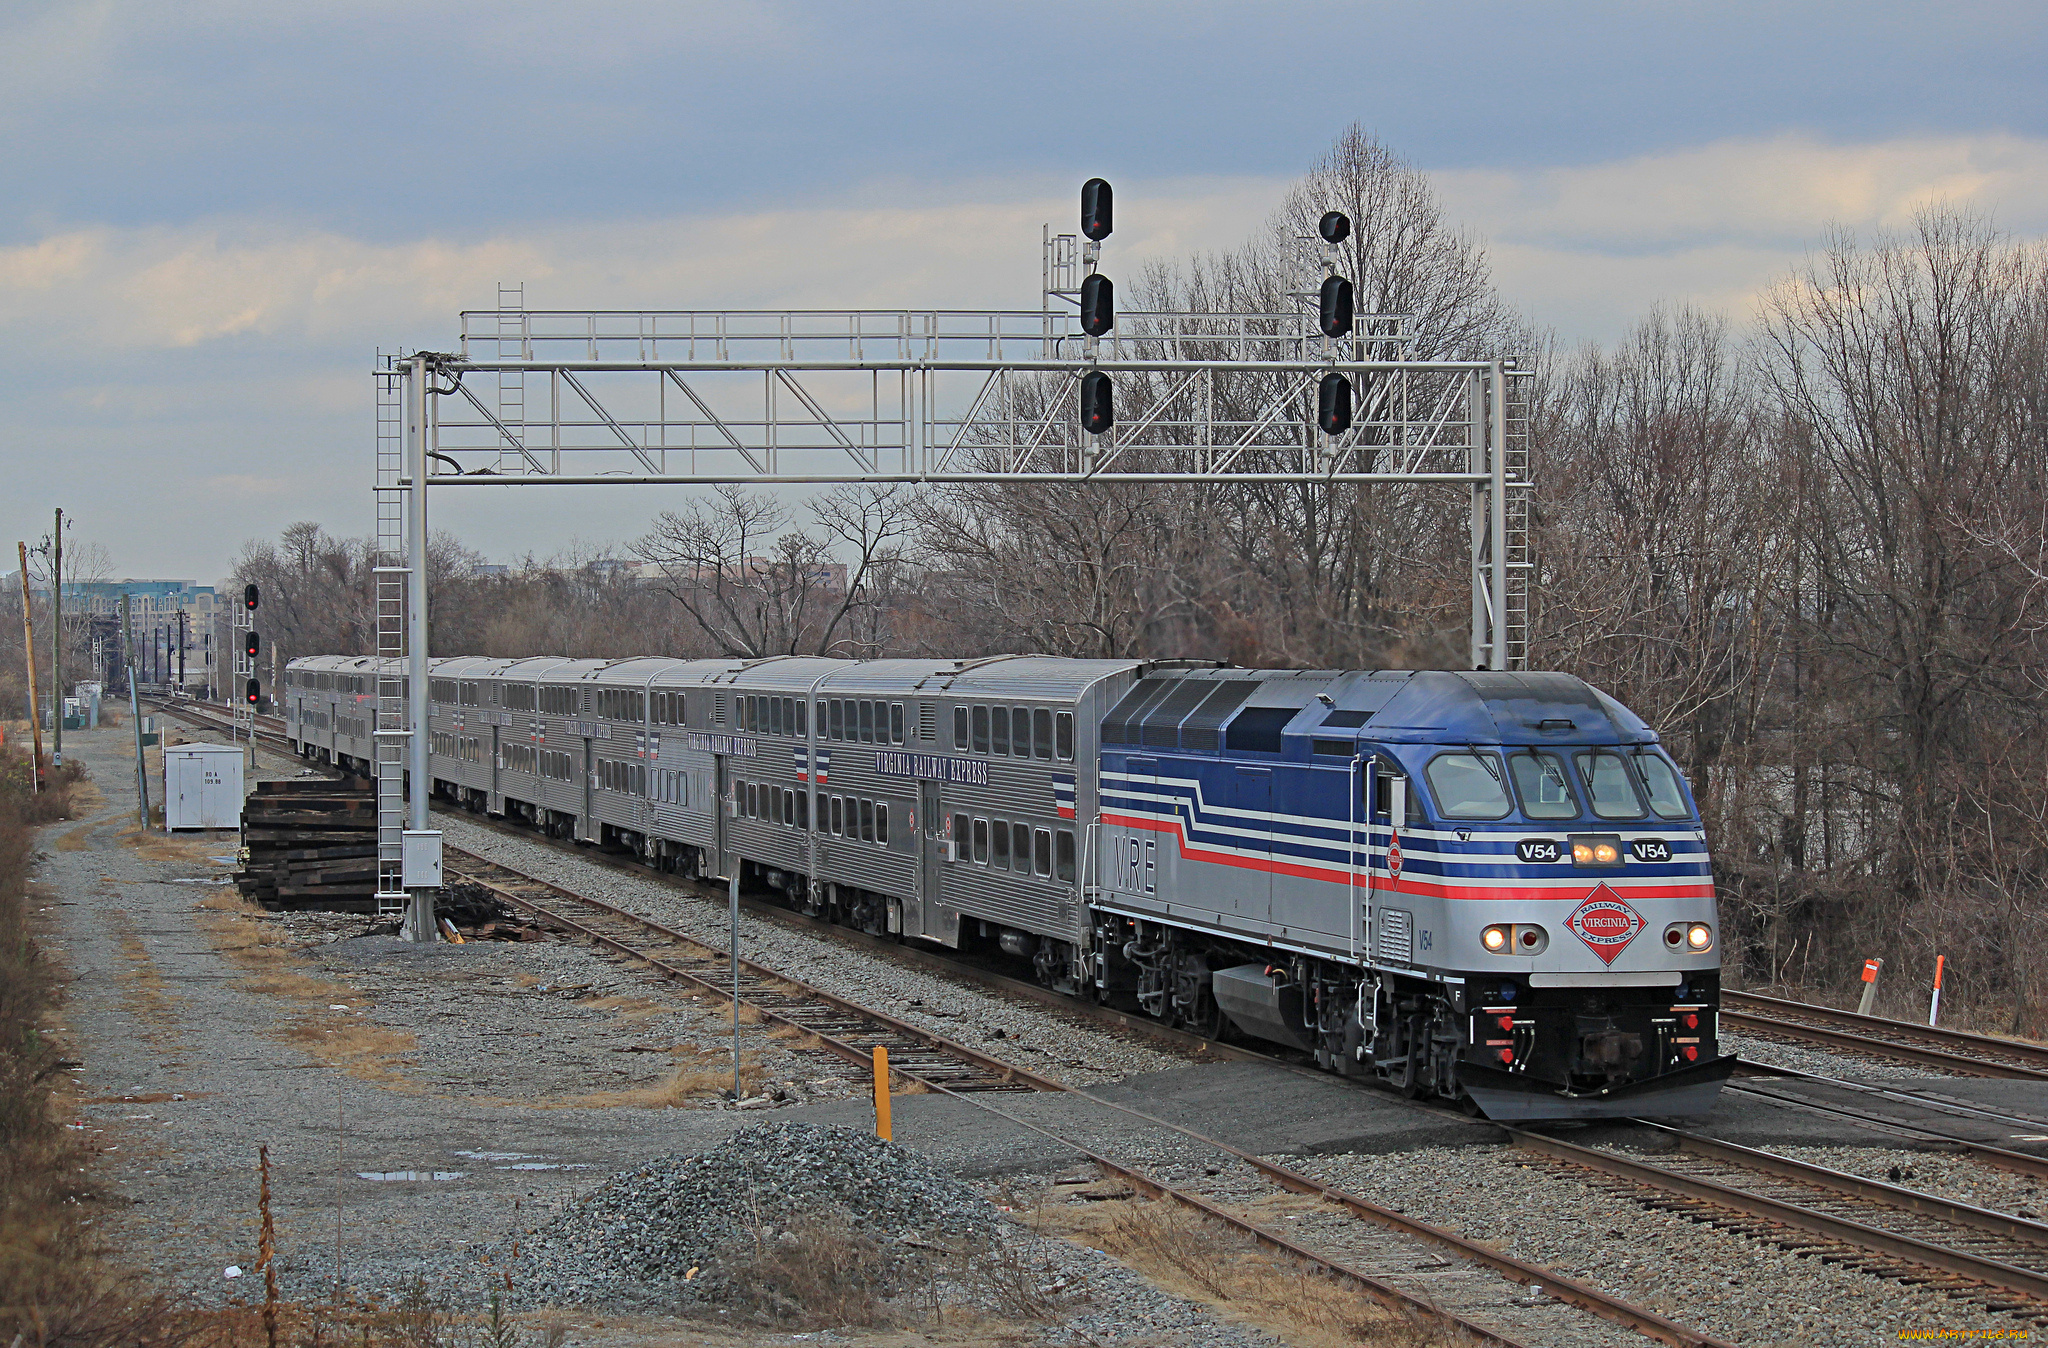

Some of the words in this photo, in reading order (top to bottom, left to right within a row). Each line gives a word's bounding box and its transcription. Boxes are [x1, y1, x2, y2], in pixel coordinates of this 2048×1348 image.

[711, 734, 733, 754] RAILWAY
[734, 737, 757, 758] EXPRESS
[876, 752, 911, 775] VIRGINIA
[913, 755, 947, 779] RAILWAY
[950, 759, 988, 785] EXPRESS
[1521, 844, 1557, 859] V54
[1634, 843, 1668, 858] V54
[1114, 835, 1156, 896] VRE
[1579, 902, 1631, 915] RAILWAY
[1582, 917, 1630, 928] VIRGINIA
[1418, 929, 1433, 951] V54
[1581, 930, 1633, 944] EXPRESS
[1455, 990, 1461, 1001] F
